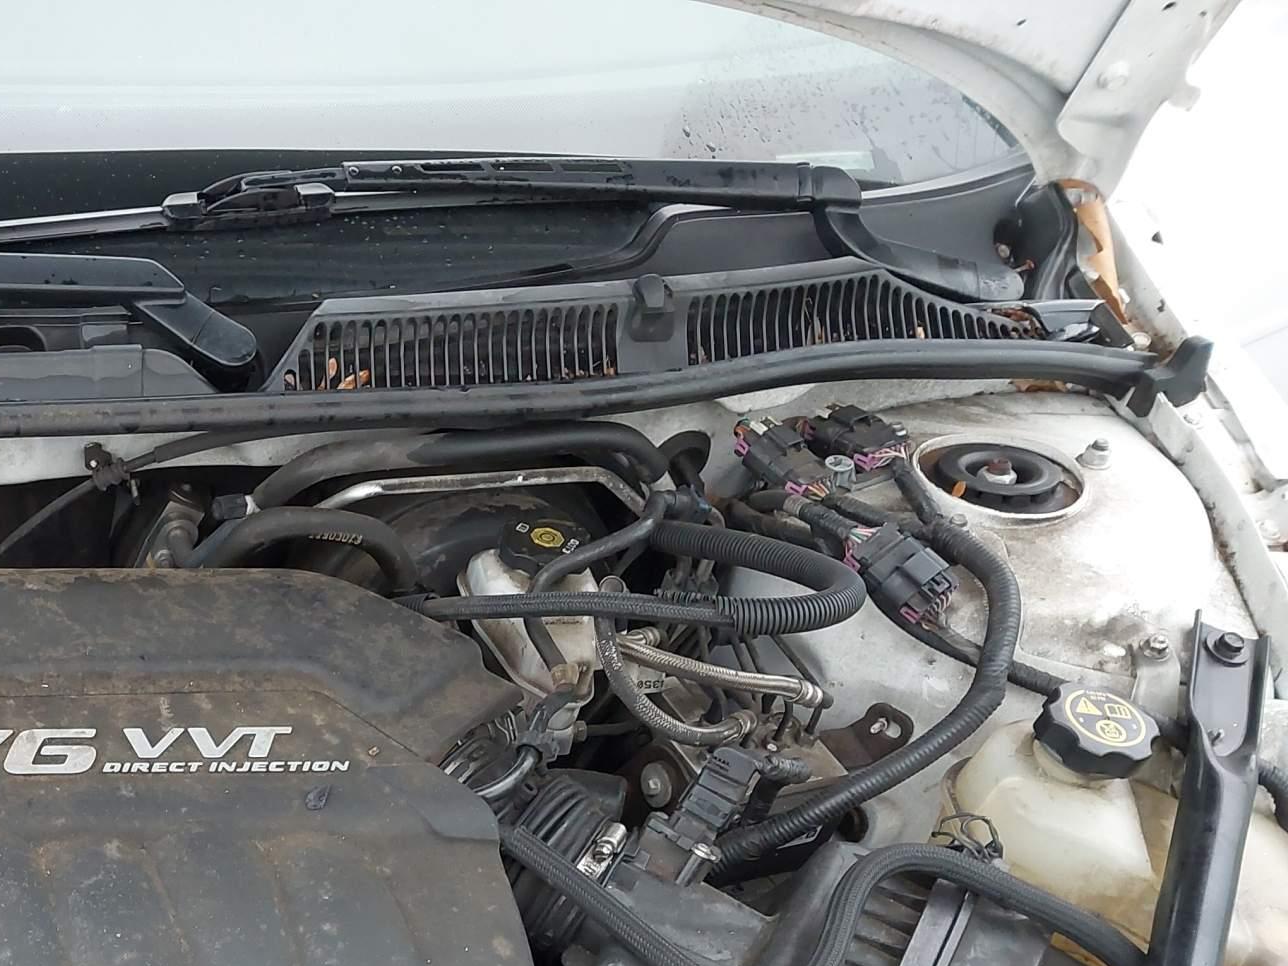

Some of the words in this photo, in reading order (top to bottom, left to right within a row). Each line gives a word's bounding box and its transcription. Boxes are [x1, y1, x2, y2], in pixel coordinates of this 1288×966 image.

[123, 726, 293, 759] VVT
[102, 761, 203, 774] DIRECT
[209, 760, 350, 774] INJECTION
